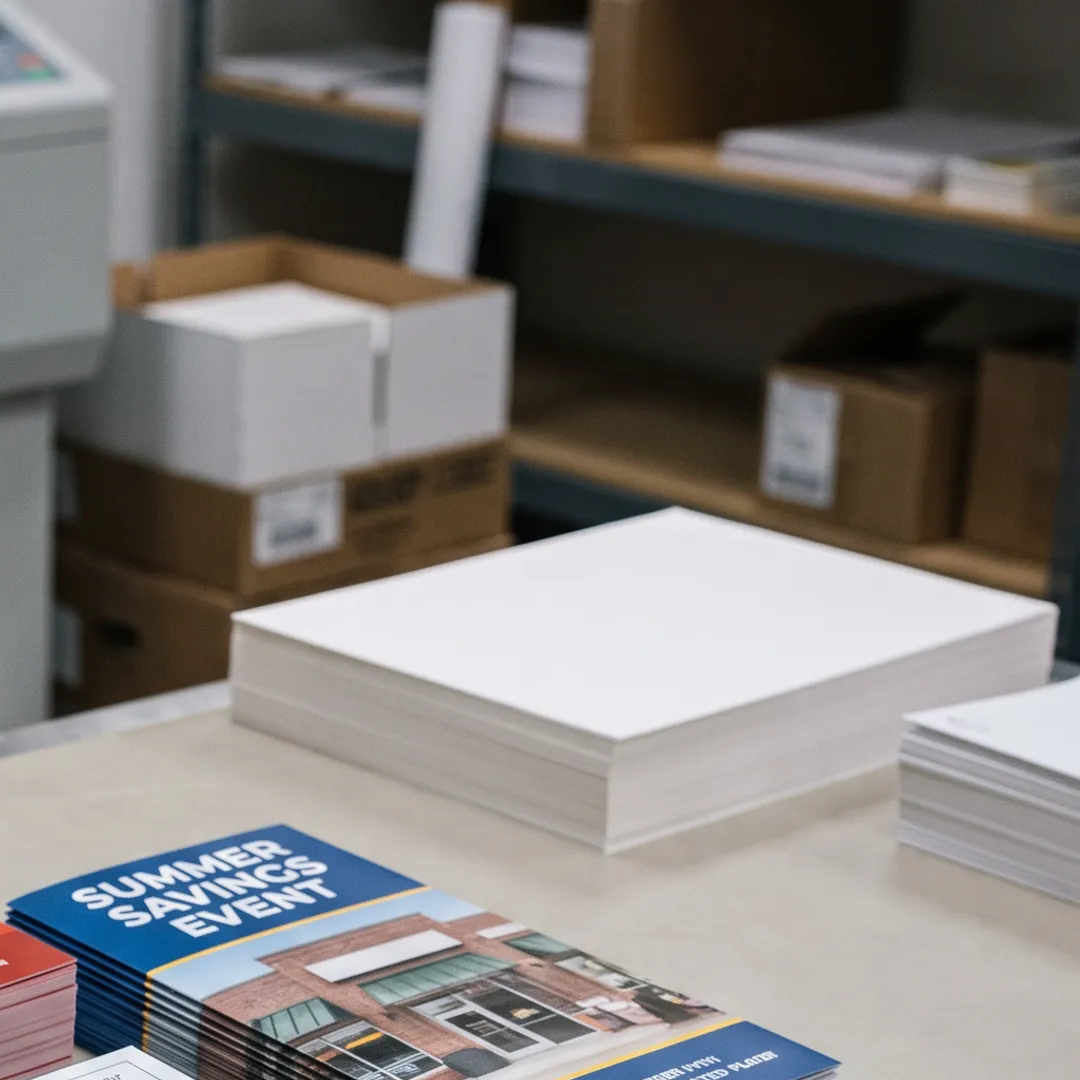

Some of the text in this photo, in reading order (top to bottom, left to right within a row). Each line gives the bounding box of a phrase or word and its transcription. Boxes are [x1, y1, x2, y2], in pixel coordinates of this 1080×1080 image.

[71, 839, 293, 910] SUMMER
[107, 855, 328, 928] SAVINGS
[169, 878, 338, 938] EVENT
